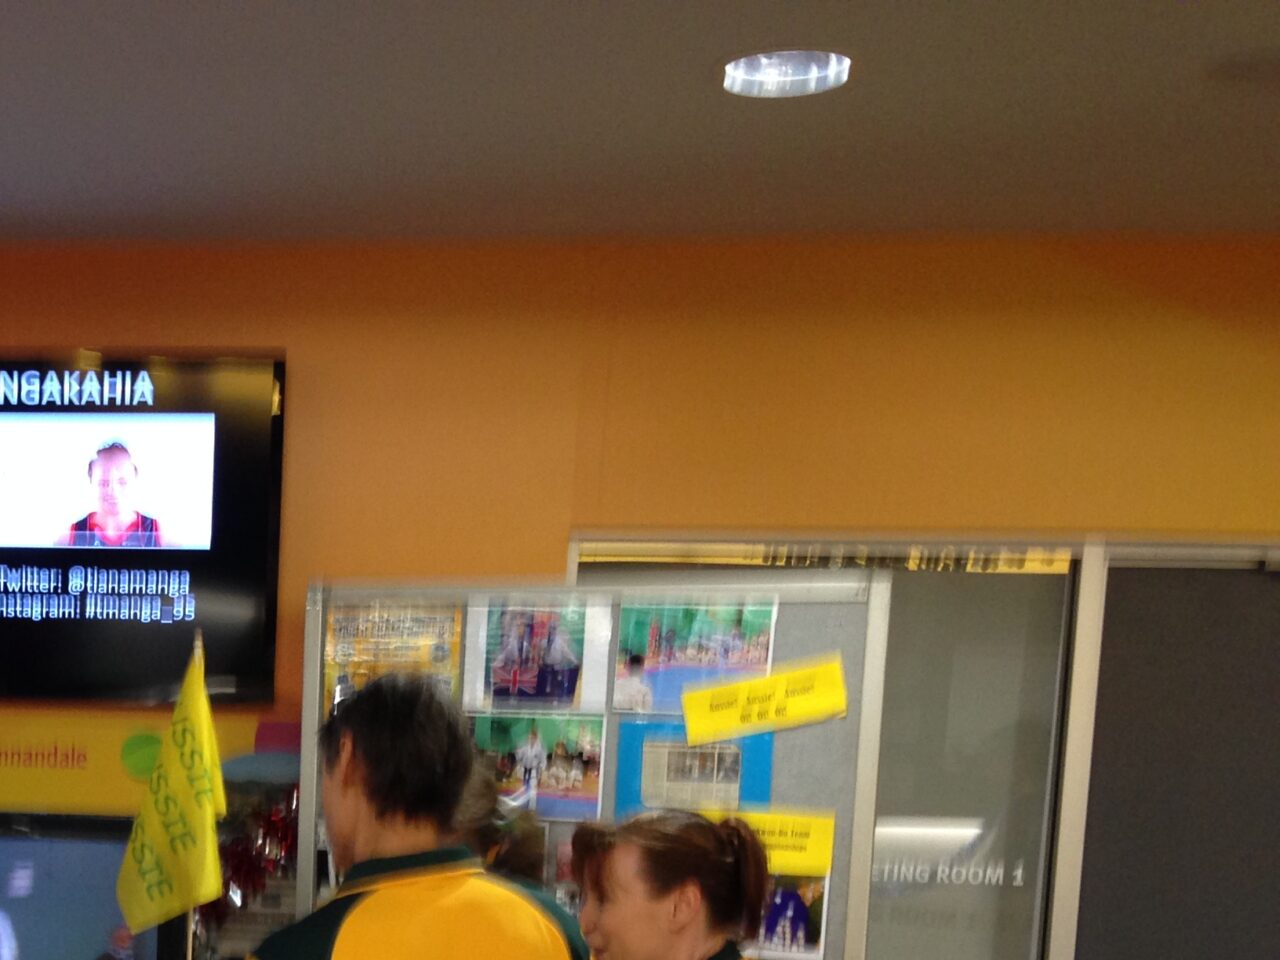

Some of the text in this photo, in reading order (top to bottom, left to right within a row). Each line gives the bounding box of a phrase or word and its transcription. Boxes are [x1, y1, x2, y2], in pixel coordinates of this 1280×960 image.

[68, 566, 190, 597] @tianamanga
[936, 863, 1004, 886] ROOM
[1012, 863, 1024, 887] 1
